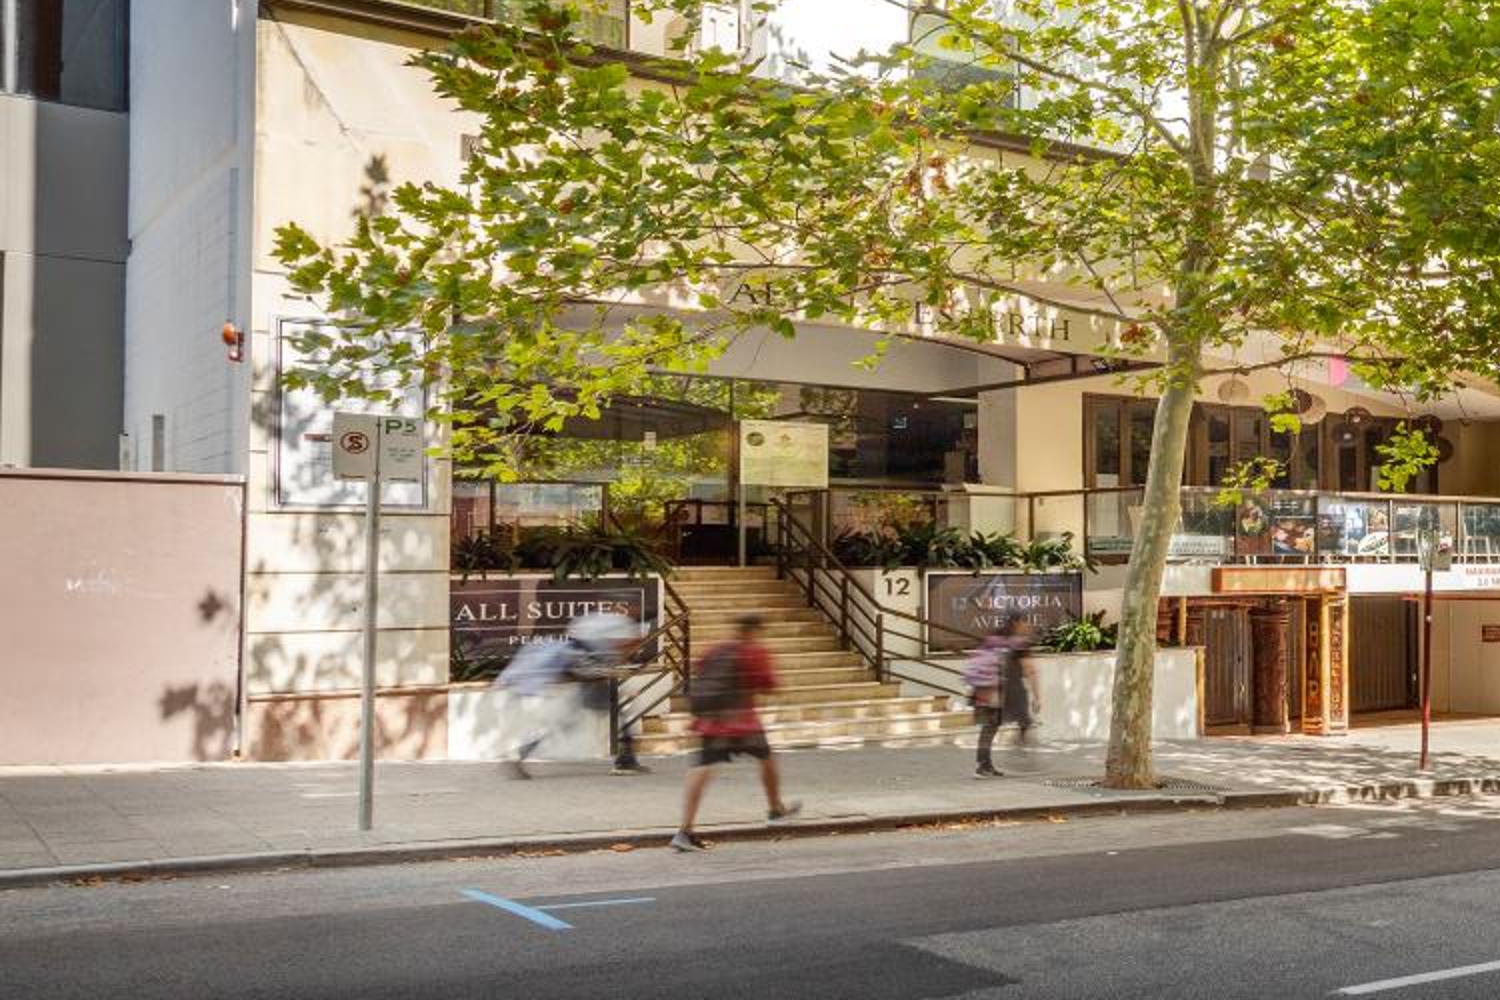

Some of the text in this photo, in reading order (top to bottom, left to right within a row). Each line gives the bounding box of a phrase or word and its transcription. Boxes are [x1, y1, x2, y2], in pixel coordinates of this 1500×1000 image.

[885, 578, 910, 596] 12
[974, 594, 1062, 610] VICTORIA
[456, 601, 629, 621] ALL SUITES
[973, 613, 1044, 630] AVEE
